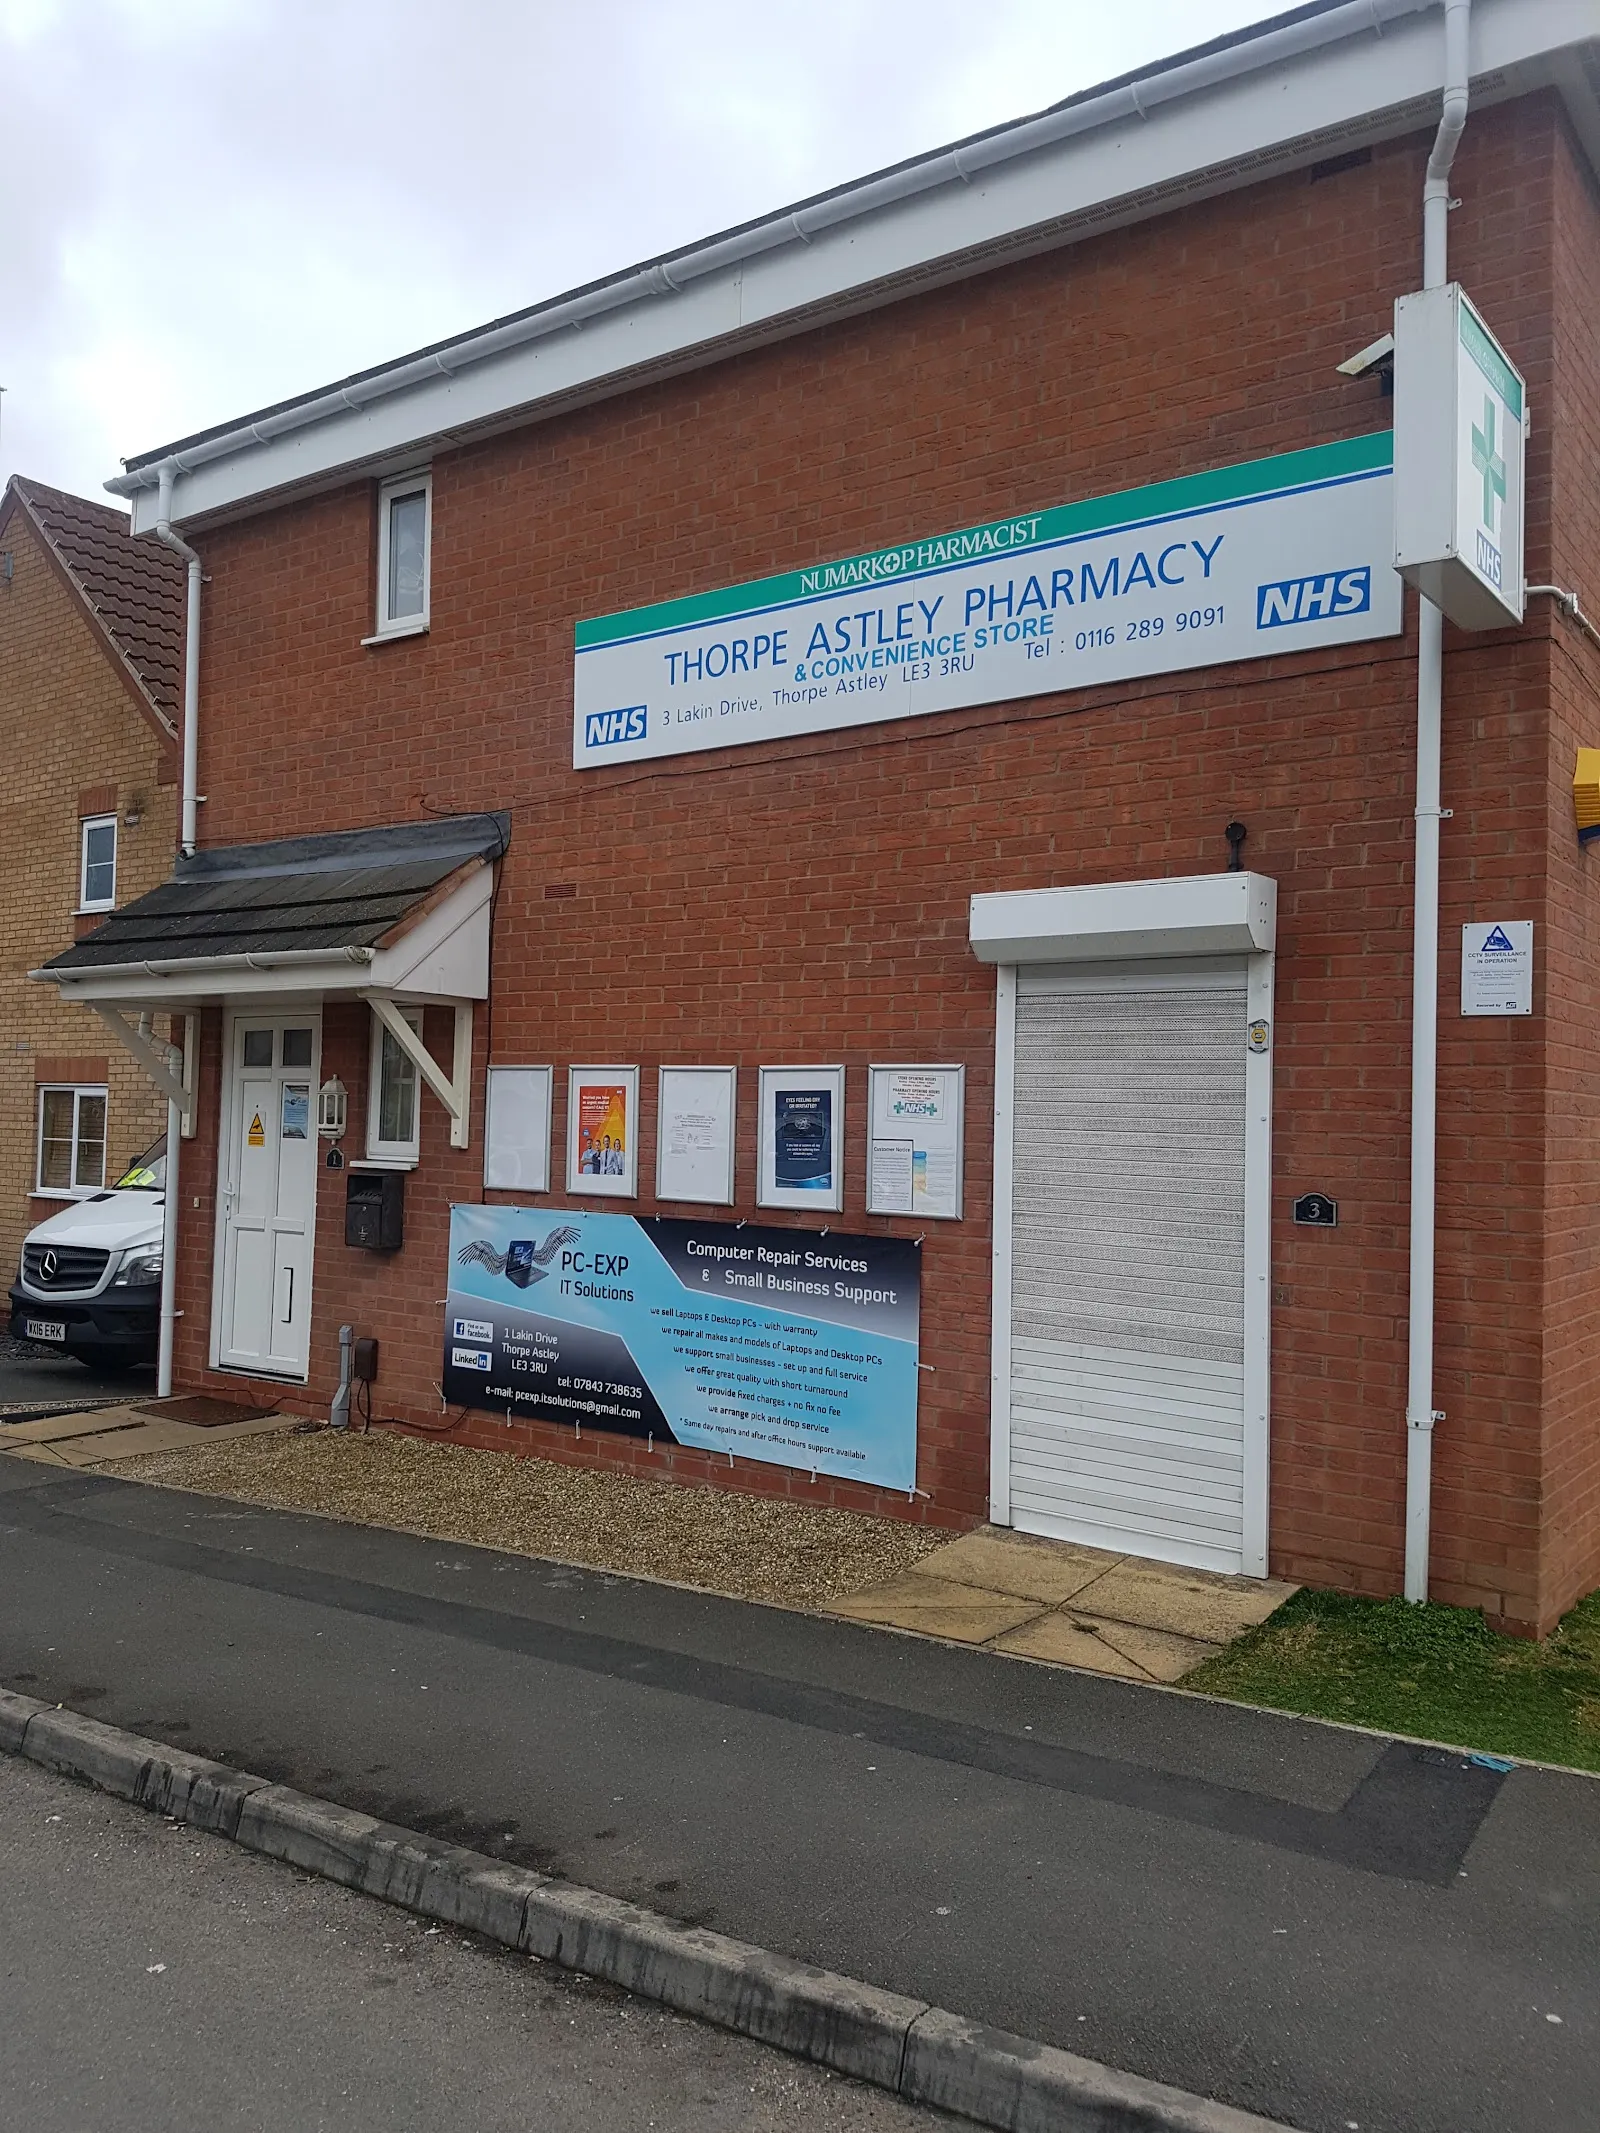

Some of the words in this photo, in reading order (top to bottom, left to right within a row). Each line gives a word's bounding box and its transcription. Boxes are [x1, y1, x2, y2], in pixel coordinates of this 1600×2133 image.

[800, 554, 886, 594] NUMARK
[902, 518, 1042, 570] PHARMACIST
[1477, 532, 1501, 588] NHS
[664, 630, 788, 686] THORPE
[806, 595, 944, 660] ASTLEY
[964, 535, 1225, 627] PHARMACY
[1258, 569, 1368, 628] NHS
[794, 663, 807, 682] &
[812, 632, 966, 680] CONVENIENCE
[974, 614, 1054, 650] STORE
[1024, 638, 1050, 660] Tel
[1075, 627, 1115, 652] 0116
[1126, 618, 1165, 642] 289
[1176, 605, 1225, 632] 9091
[662, 710, 670, 726] 3
[677, 701, 713, 724] Lakin
[720, 697, 764, 717] Drive,
[773, 682, 828, 707] Thorpe
[836, 673, 888, 696] Astley
[903, 661, 931, 684] LE3
[940, 653, 975, 678] 3RU
[587, 706, 646, 746] NHS
[905, 1103, 926, 1113] NHS
[332, 1154, 337, 1165] 1
[1309, 1203, 1320, 1218] 3
[562, 1251, 628, 1276] PC-EXP
[686, 1240, 754, 1261] Computer
[757, 1247, 801, 1267] Repair
[805, 1252, 868, 1273] Services
[560, 1279, 571, 1294] IT
[574, 1281, 634, 1301] Solutions
[725, 1270, 762, 1288] Small
[767, 1274, 830, 1296] Business
[834, 1282, 897, 1305] Support
[45, 1324, 62, 1338] ERK
[504, 1328, 510, 1338] 1
[512, 1328, 533, 1341] Lakin
[535, 1332, 558, 1344] Drive
[661, 1308, 673, 1316] sell
[675, 1309, 702, 1322] Laptops
[711, 1314, 740, 1327] Desktop
[742, 1318, 757, 1328] PCs
[764, 1321, 780, 1331] with
[783, 1326, 818, 1338] warranty
[501, 1342, 530, 1357] Thorpe
[532, 1347, 559, 1363] Astley
[673, 1328, 694, 1338] repair
[695, 1330, 703, 1338] all
[705, 1332, 728, 1342] makes
[729, 1336, 742, 1344] and
[744, 1338, 770, 1348] models
[772, 1341, 781, 1350] of
[782, 1343, 812, 1355] Laptops
[814, 1348, 828, 1357] and
[831, 1349, 864, 1363] Desktop
[866, 1355, 882, 1365] PCs
[511, 1359, 527, 1371] LE3
[529, 1361, 548, 1374] 3RU
[685, 1347, 714, 1358] support
[715, 1351, 734, 1360] small
[736, 1353, 775, 1368] businesses
[783, 1361, 796, 1371] set
[797, 1364, 807, 1374] up
[809, 1366, 823, 1375] and
[825, 1367, 838, 1378] full
[839, 1371, 868, 1382] service
[557, 1376, 571, 1388] tel:
[573, 1378, 603, 1393] 07843
[605, 1382, 643, 1399] 738635
[685, 1365, 694, 1373] we
[696, 1366, 715, 1376] offer
[716, 1370, 735, 1379] great
[736, 1372, 761, 1385] quality
[763, 1376, 780, 1387] with
[781, 1379, 802, 1391] short
[804, 1384, 848, 1398] turnaround
[485, 1385, 514, 1399] e-mail:
[515, 1390, 641, 1419] pcexp.itsolutions@gmail.com
[696, 1385, 706, 1393] we
[708, 1387, 736, 1398] provide
[738, 1389, 755, 1401] fixed
[756, 1394, 785, 1407] charges
[805, 1401, 815, 1412] fix
[817, 1406, 826, 1414] no
[829, 1405, 841, 1416] fee
[708, 1405, 718, 1413] we
[720, 1407, 749, 1420] arrange
[751, 1411, 766, 1421] pick
[767, 1415, 780, 1424] and
[783, 1417, 800, 1429] drop
[802, 1422, 829, 1433] service
[684, 1418, 701, 1428] Same
[702, 1422, 714, 1432] day
[715, 1424, 737, 1435] repairs
[738, 1429, 750, 1437] and
[751, 1430, 767, 1440] after
[768, 1434, 786, 1444] office
[788, 1437, 806, 1448] hours
[808, 1443, 834, 1454] support
[836, 1448, 866, 1460] available
